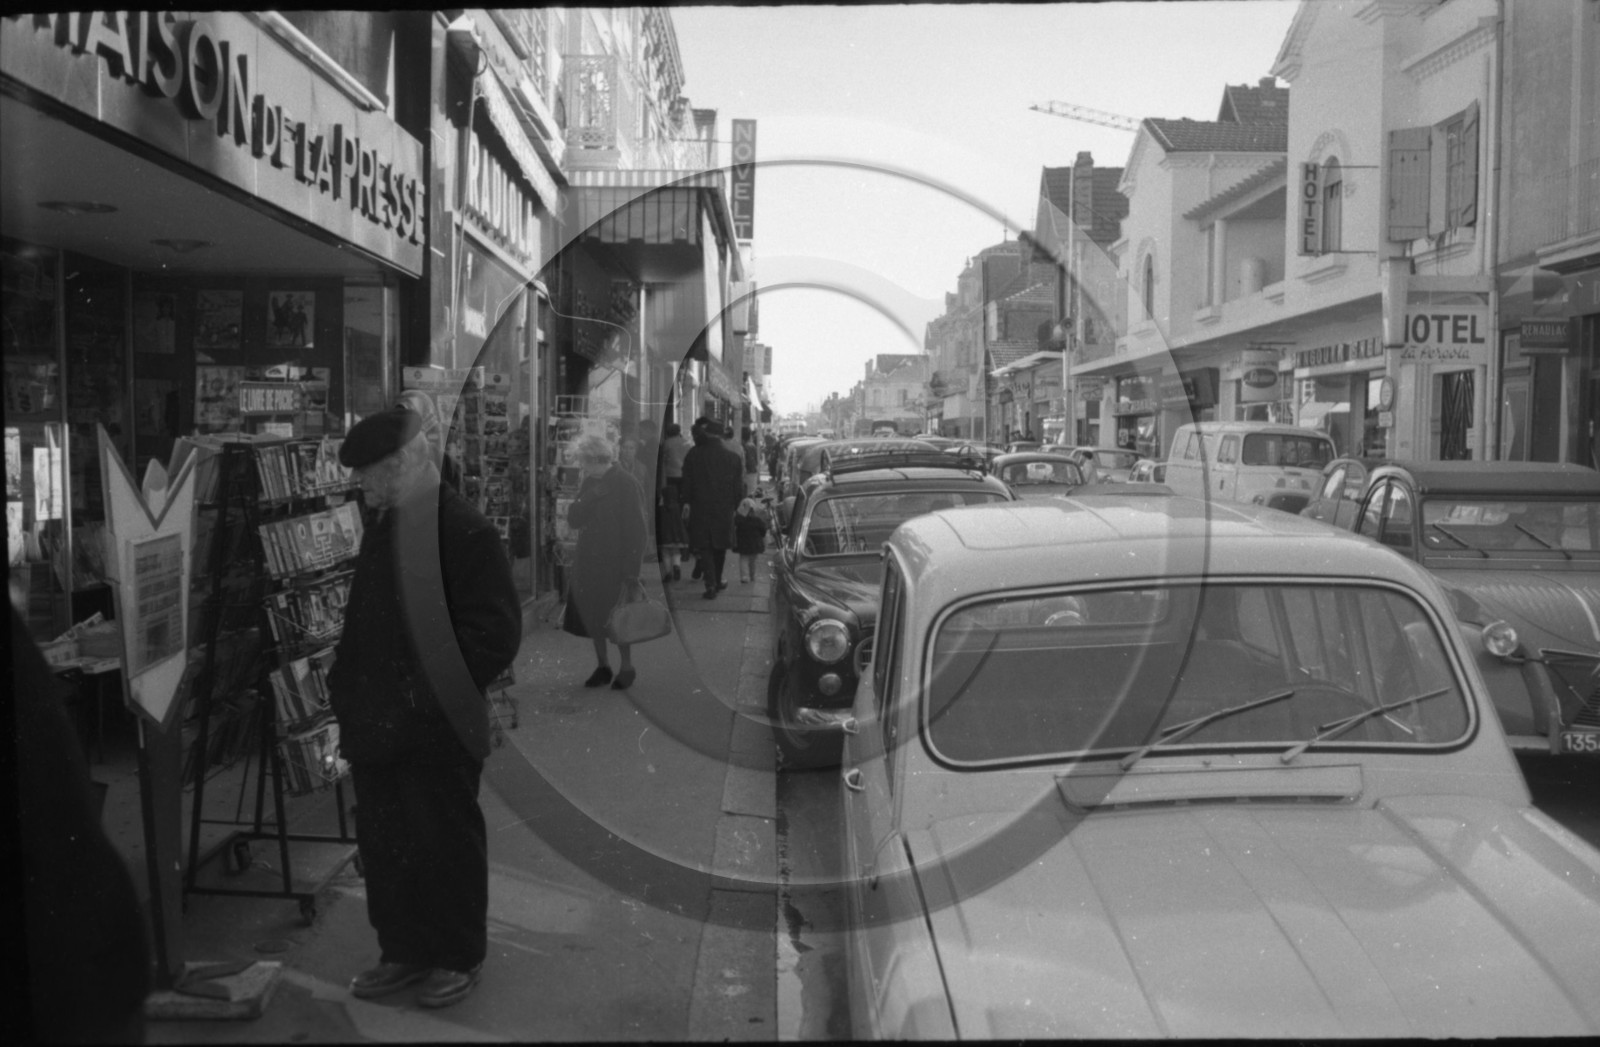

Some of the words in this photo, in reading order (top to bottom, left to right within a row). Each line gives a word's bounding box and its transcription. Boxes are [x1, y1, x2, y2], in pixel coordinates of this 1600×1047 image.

[263, 104, 294, 168] DE
[303, 121, 334, 196] LA
[341, 126, 425, 245] PRESSE
[468, 130, 540, 258] RADIOLA
[1304, 163, 1317, 253] HOTEL
[1564, 733, 1600, 751] 135
